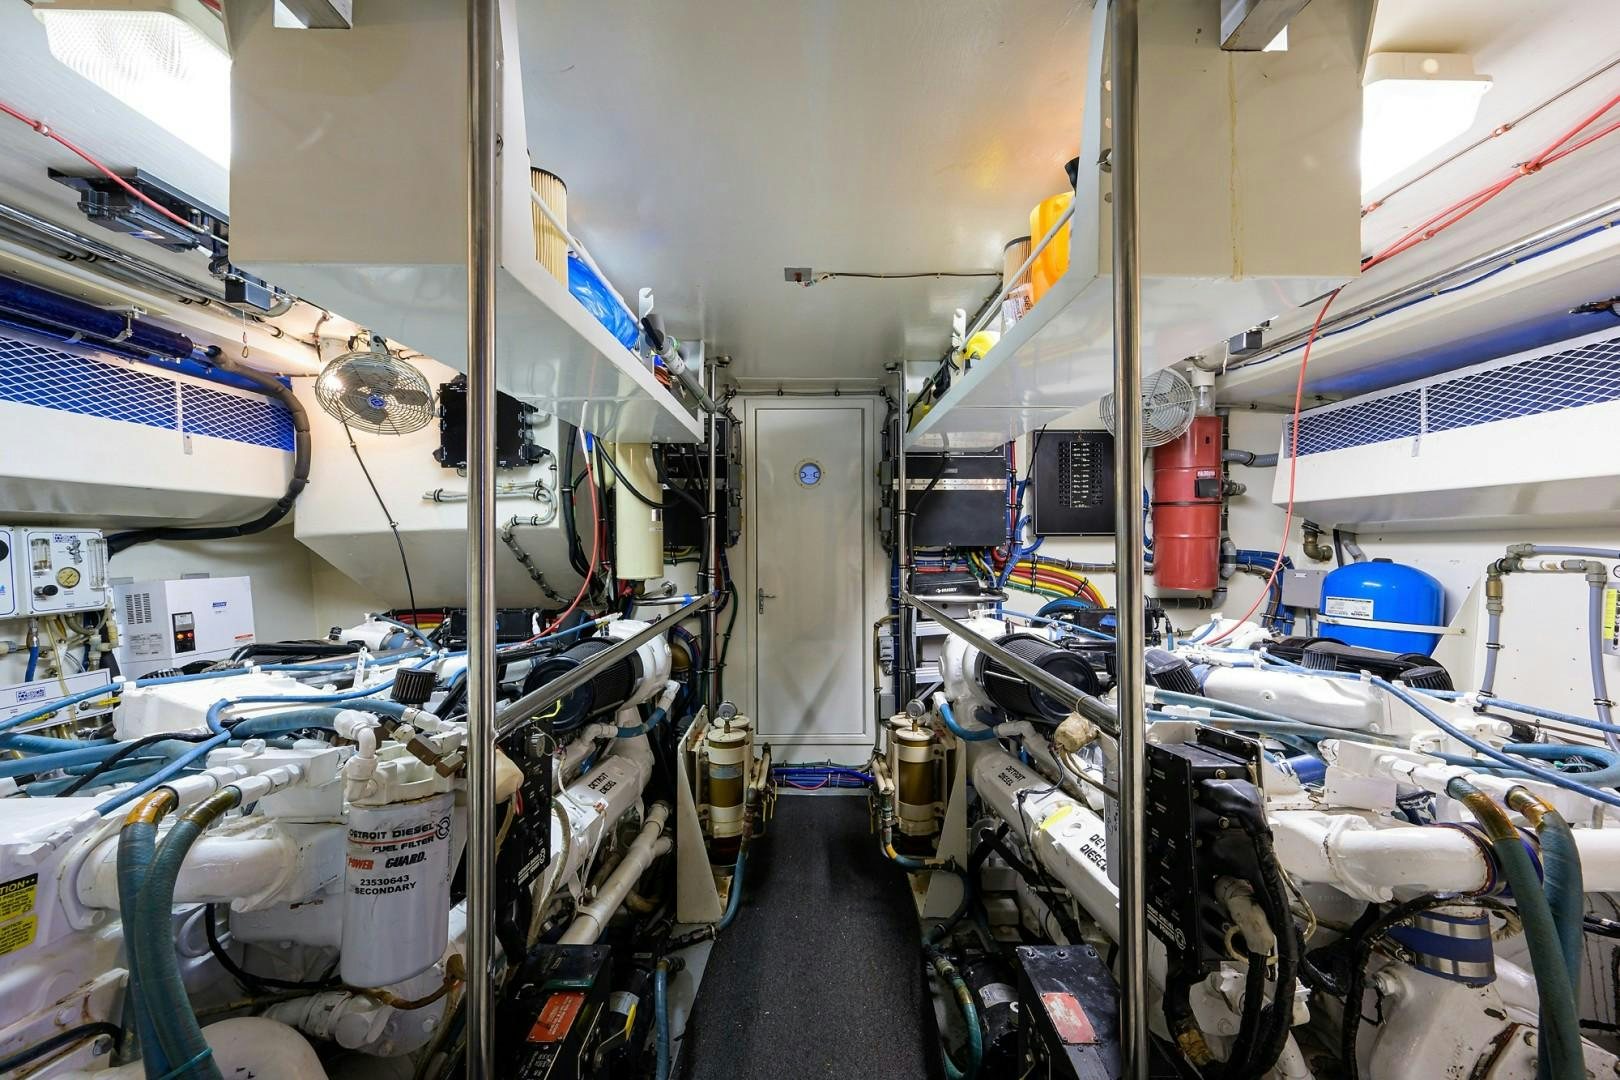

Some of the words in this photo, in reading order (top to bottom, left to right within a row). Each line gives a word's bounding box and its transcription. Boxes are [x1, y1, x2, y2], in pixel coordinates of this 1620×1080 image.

[350, 829, 387, 840] DETROIT
[392, 822, 434, 837] DIESEL
[372, 844, 398, 853] FUEL
[401, 835, 434, 850] FILTER
[348, 857, 374, 870] POWER
[360, 874, 410, 886] 23530643
[0, 880, 26, 895] TION
[355, 881, 417, 895] SECONDARY
